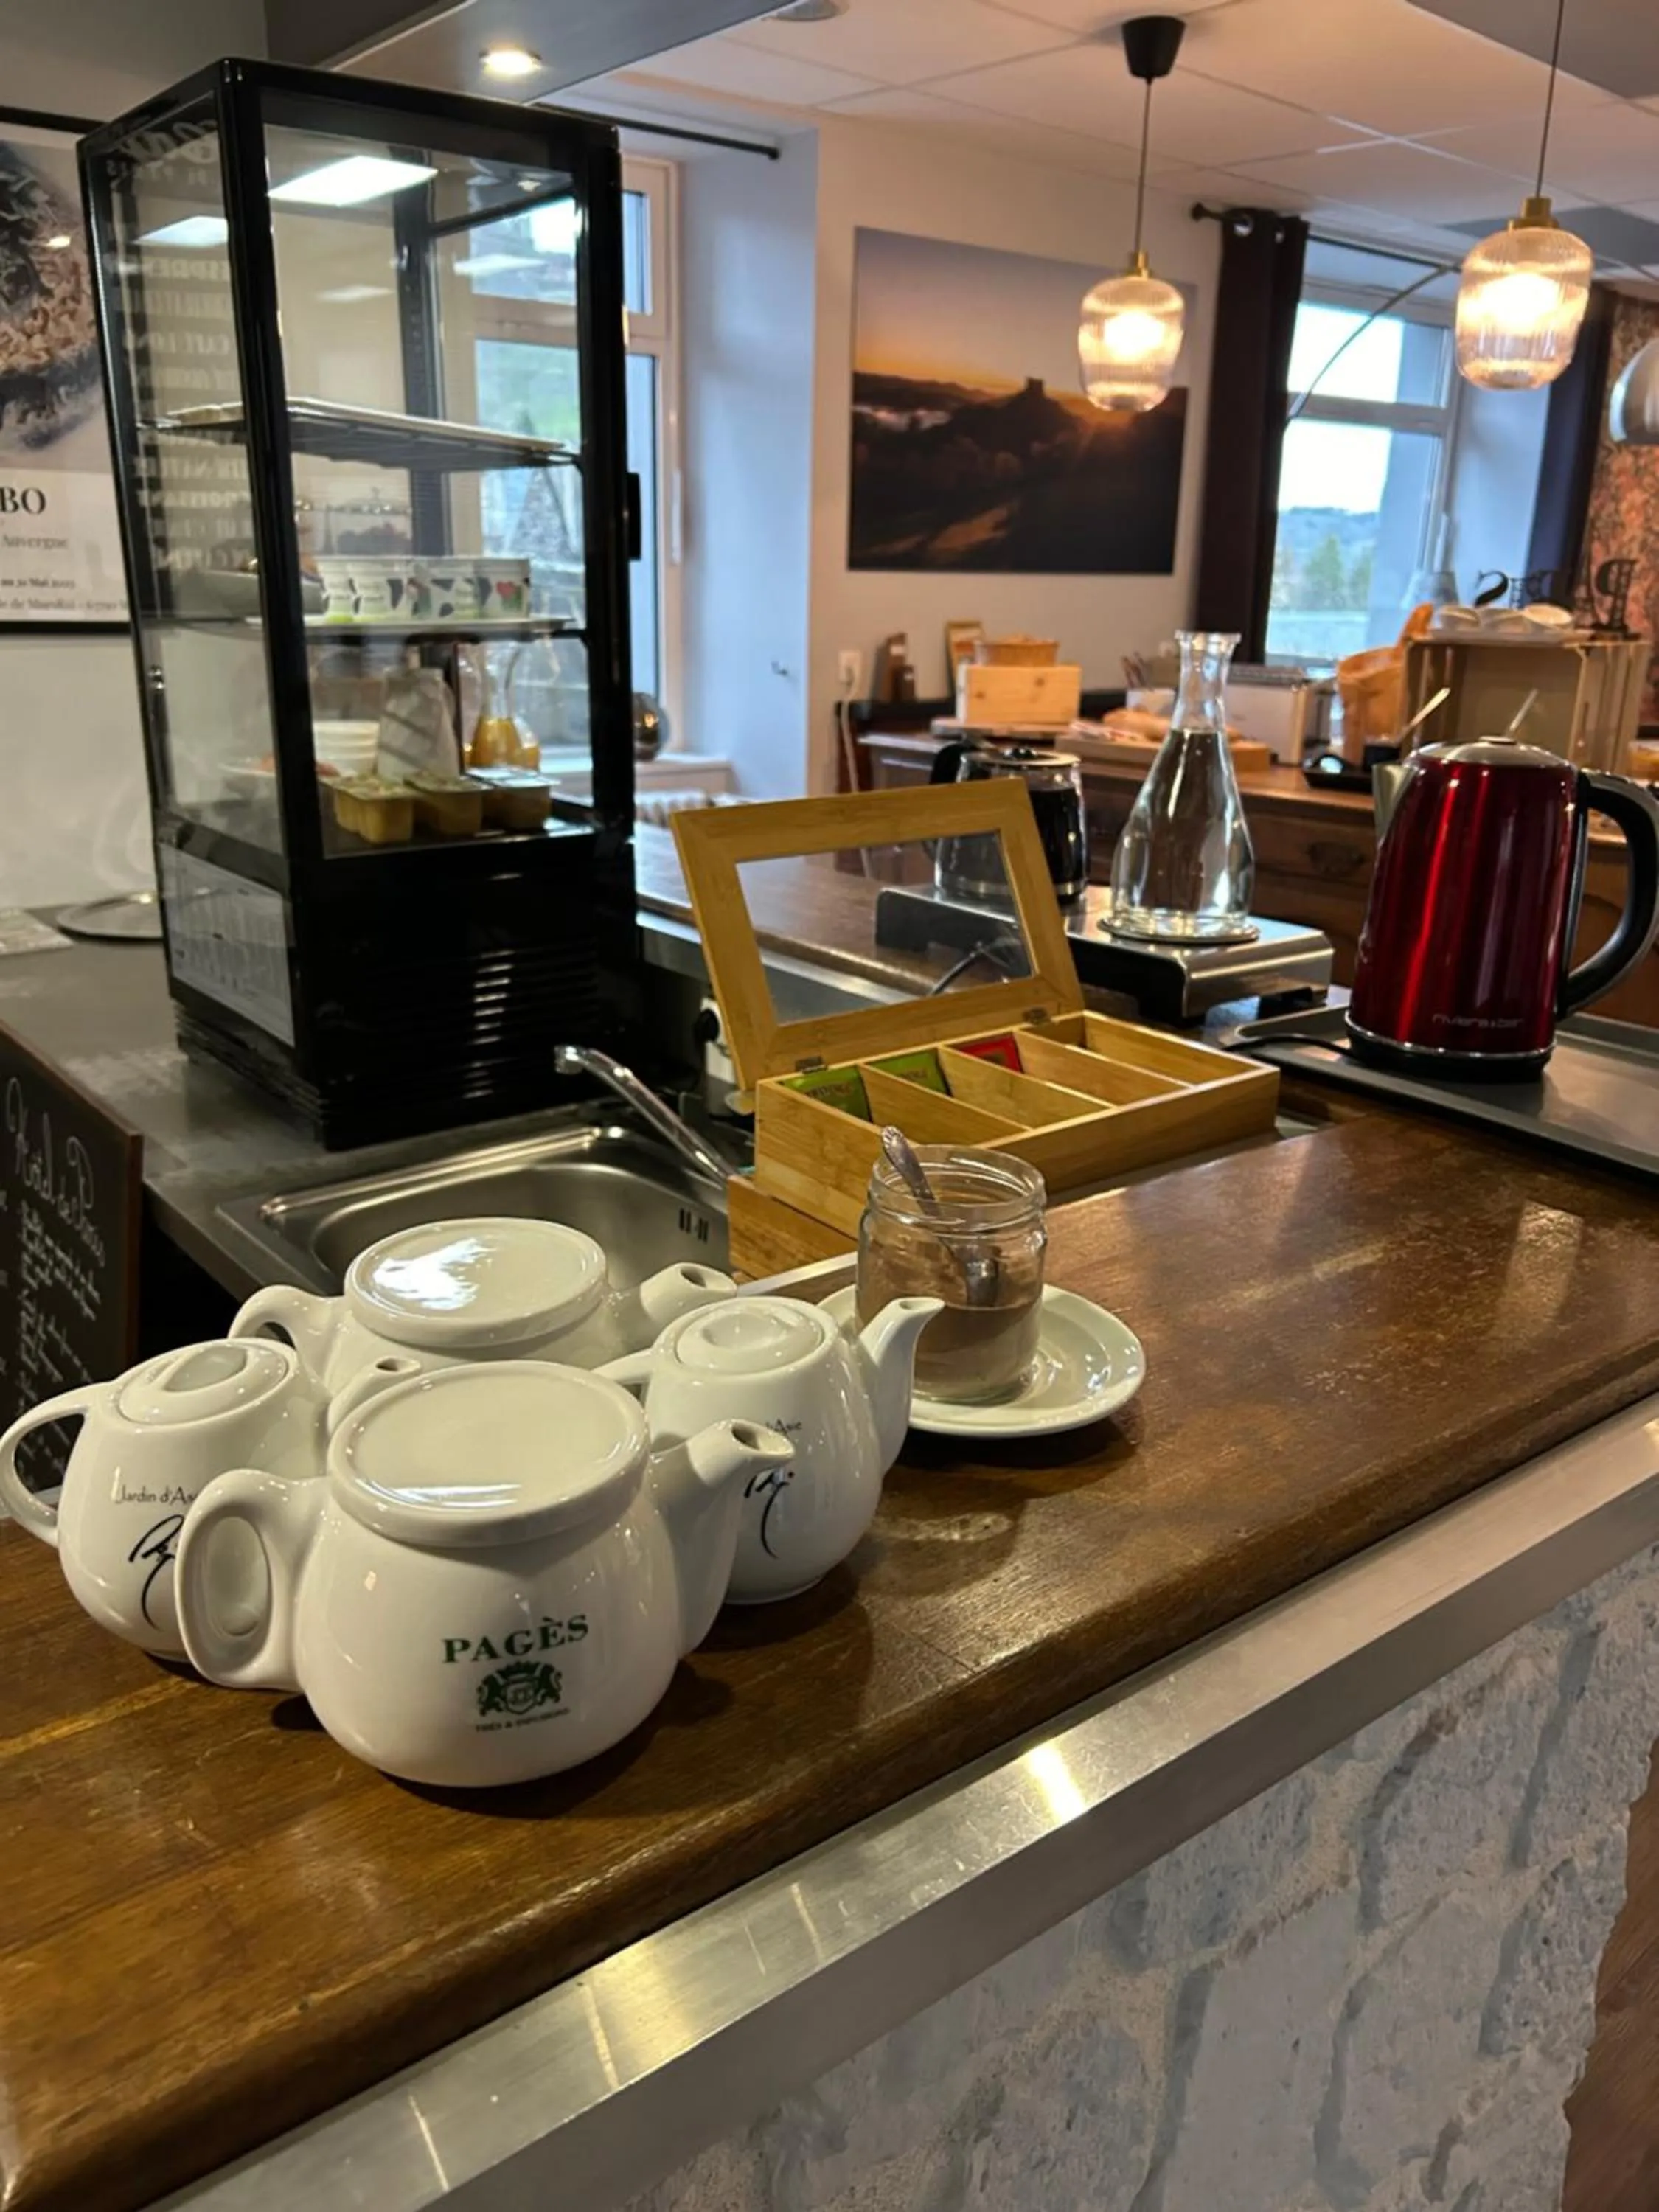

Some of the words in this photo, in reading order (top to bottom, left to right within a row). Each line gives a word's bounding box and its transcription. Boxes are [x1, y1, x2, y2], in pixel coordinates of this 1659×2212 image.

[2, 534, 69, 550] Auvergne
[114, 1483, 157, 1505] Jardin
[442, 1613, 589, 1663] PAGÈS
